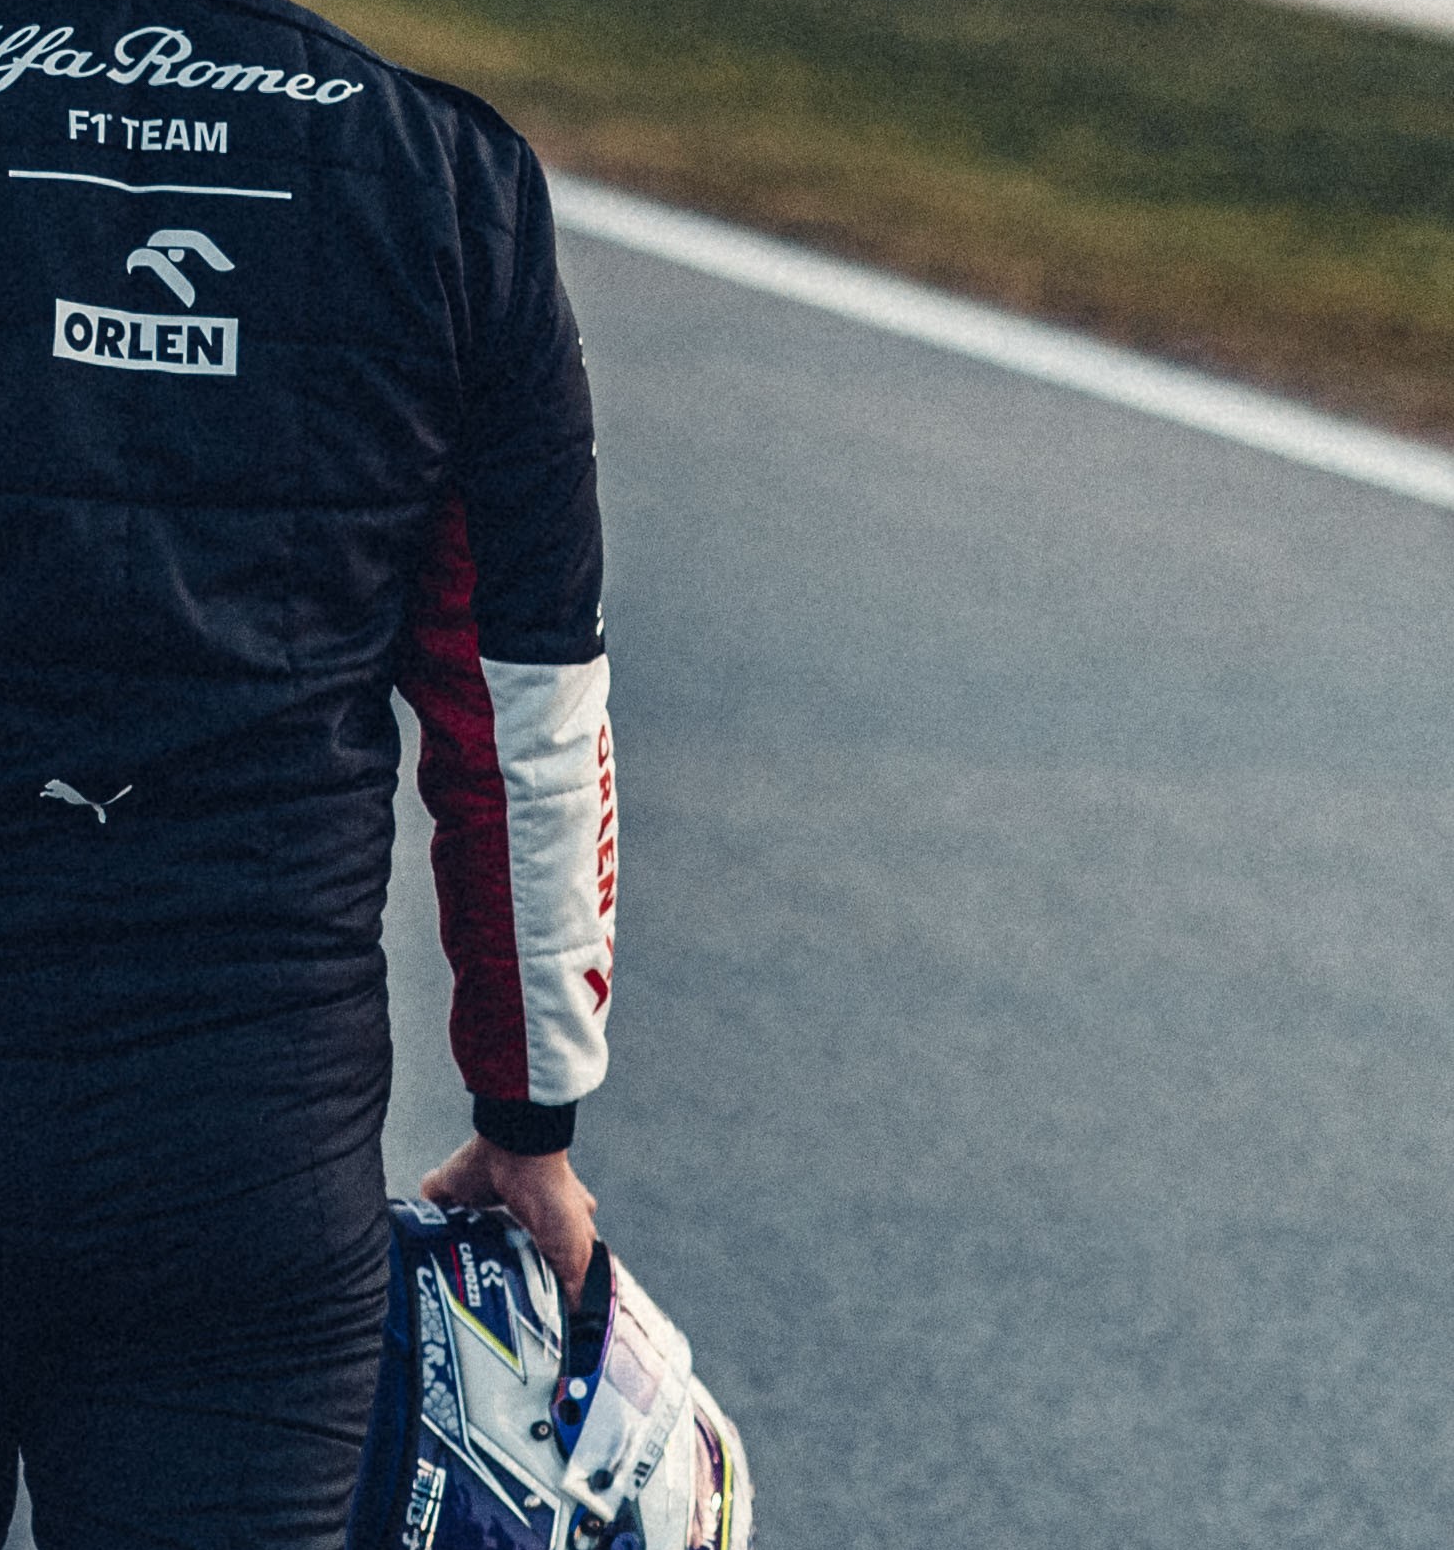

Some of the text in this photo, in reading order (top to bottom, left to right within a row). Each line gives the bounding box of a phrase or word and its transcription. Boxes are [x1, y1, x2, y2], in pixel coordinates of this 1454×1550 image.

[107, 26, 364, 105] Romeo
[122, 116, 228, 154] TEAM
[63, 311, 225, 365] ORLEN
